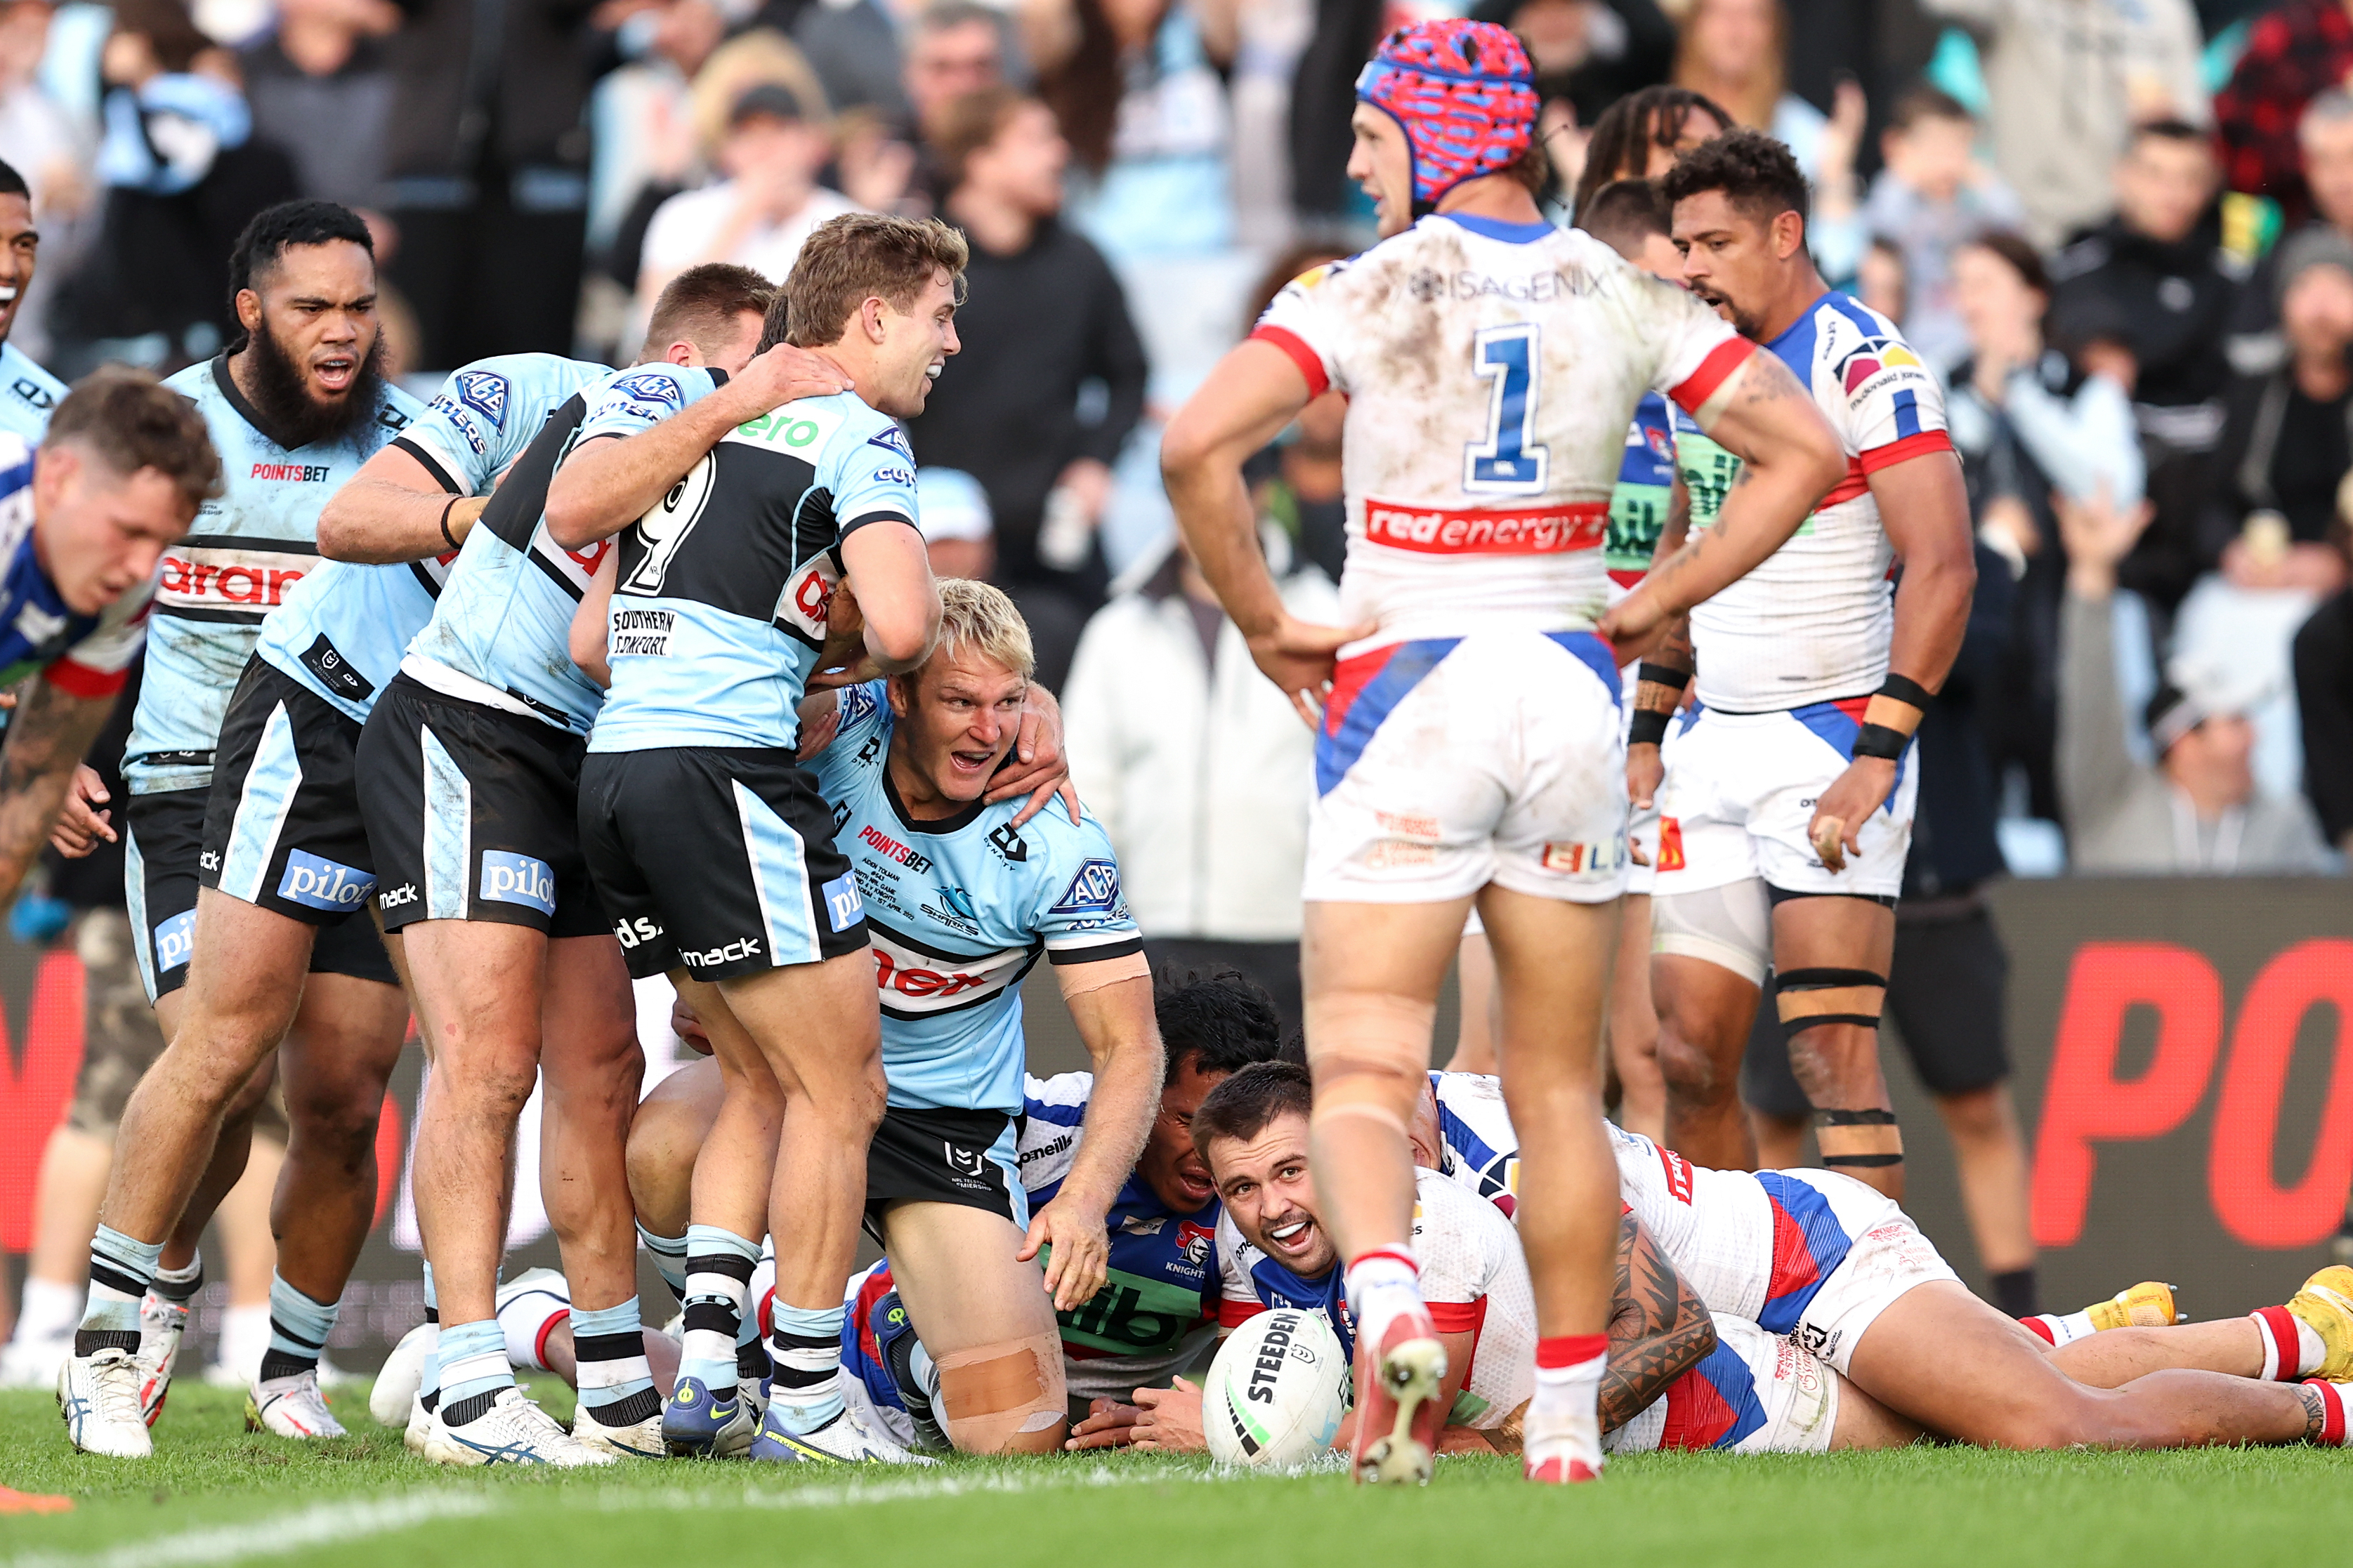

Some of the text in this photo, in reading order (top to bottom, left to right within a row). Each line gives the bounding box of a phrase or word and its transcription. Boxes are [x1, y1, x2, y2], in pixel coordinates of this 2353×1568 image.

[1450, 268, 1611, 304] ISAGENIX
[467, 372, 505, 411] ACE
[1464, 324, 1548, 494] 1
[251, 463, 329, 482] POINTSBET
[1370, 509, 1582, 550] red energy
[613, 610, 675, 633] SOUTHERN
[858, 824, 934, 875] POINTSBET
[282, 864, 374, 904] pilot
[485, 859, 555, 908] pilot
[862, 857, 900, 883] AIDEN TOLMAN
[869, 877, 879, 887] NRL
[880, 883, 896, 895] GAME
[1075, 864, 1114, 902] ACE
[379, 882, 419, 911] mack
[874, 888, 897, 904] KNIGHTS
[886, 902, 902, 914] APRIL
[903, 910, 915, 921] 2022
[919, 903, 979, 936] SHARKS
[1247, 1312, 1301, 1404] STEEDEN
